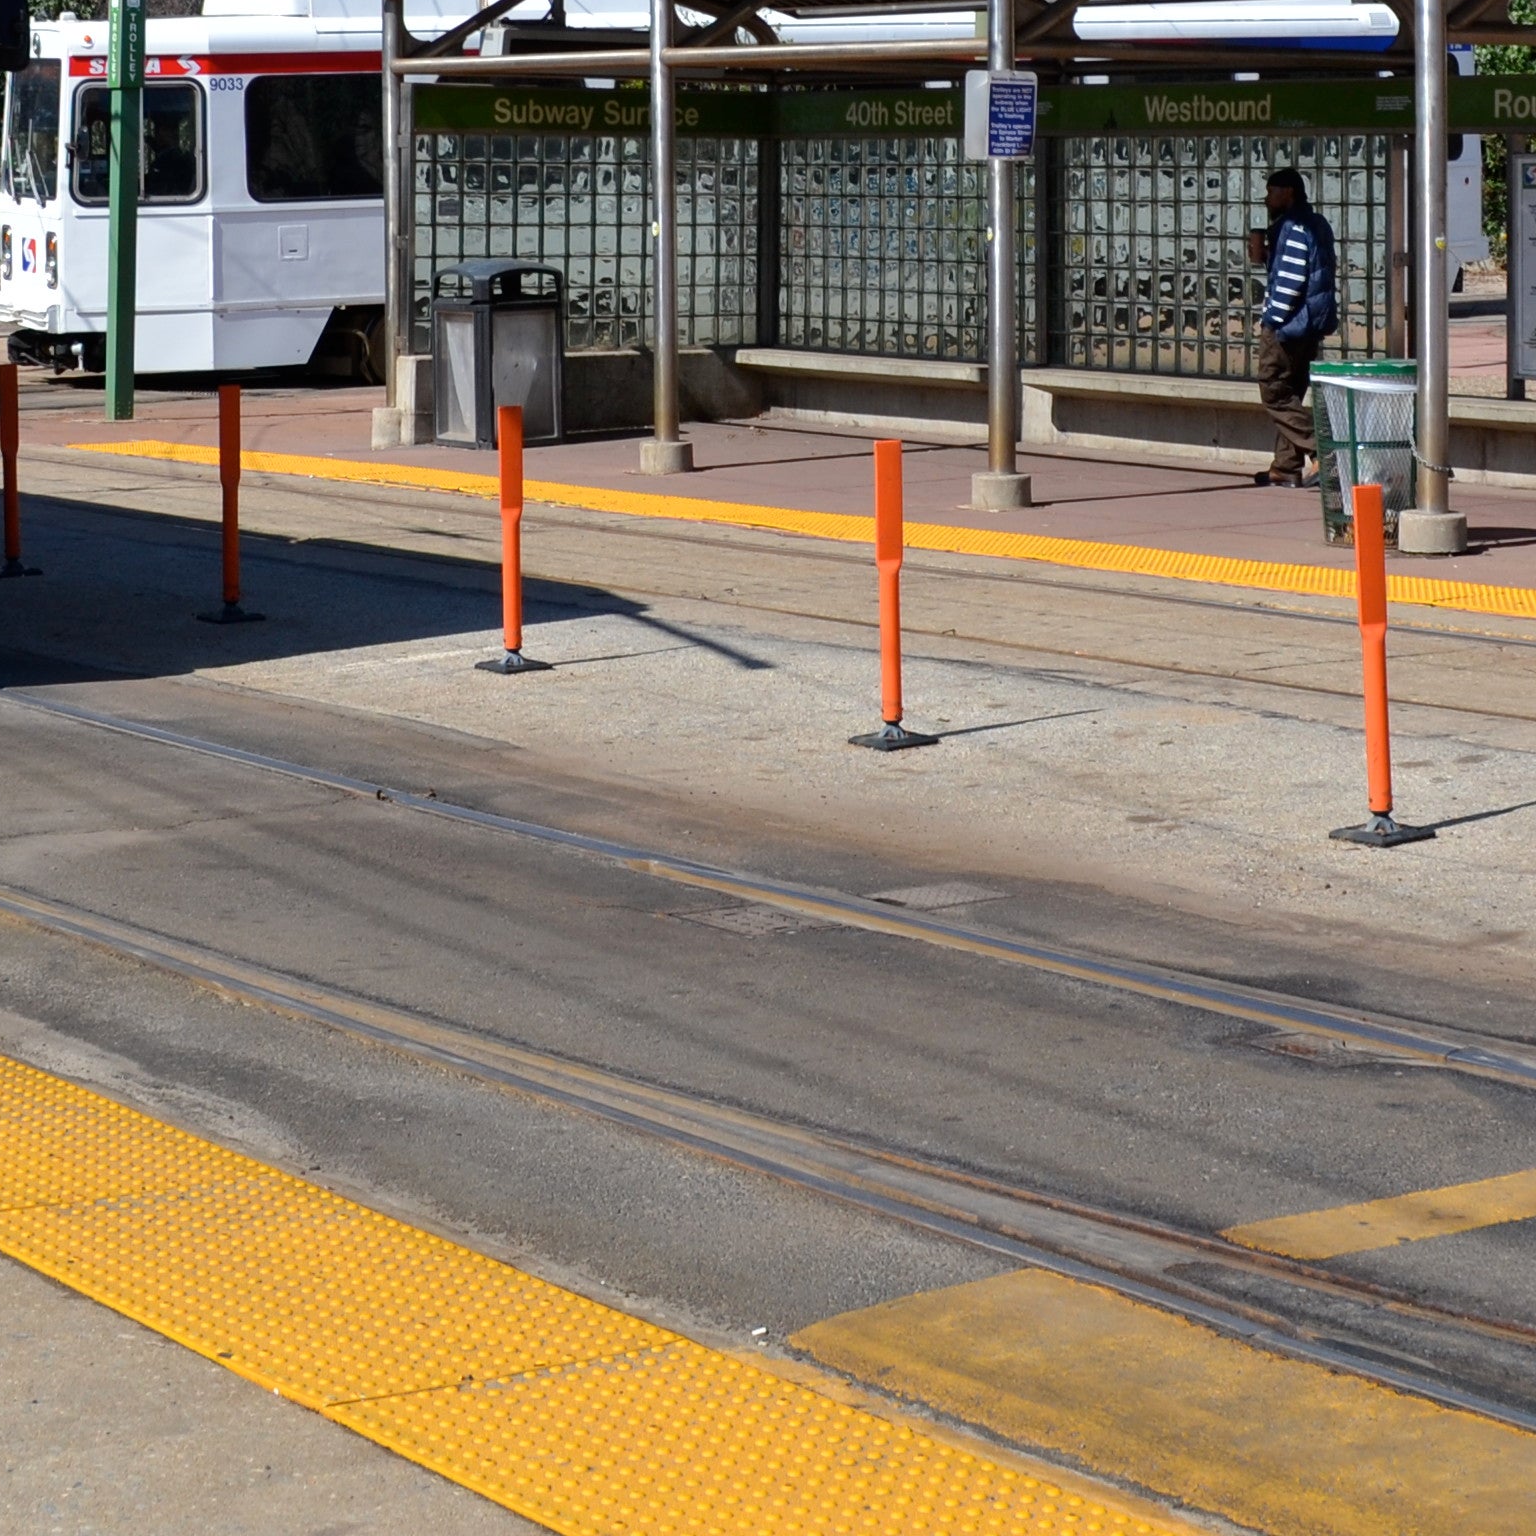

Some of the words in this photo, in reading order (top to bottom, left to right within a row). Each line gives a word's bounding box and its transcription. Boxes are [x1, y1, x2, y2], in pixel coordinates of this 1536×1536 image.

[129, 14, 137, 82] TROLLEY
[210, 78, 244, 91] 9033
[494, 98, 594, 130] Subway
[605, 101, 699, 126] Surce
[846, 101, 889, 126] 40th
[895, 100, 953, 126] Street
[1145, 94, 1272, 123] Westbound
